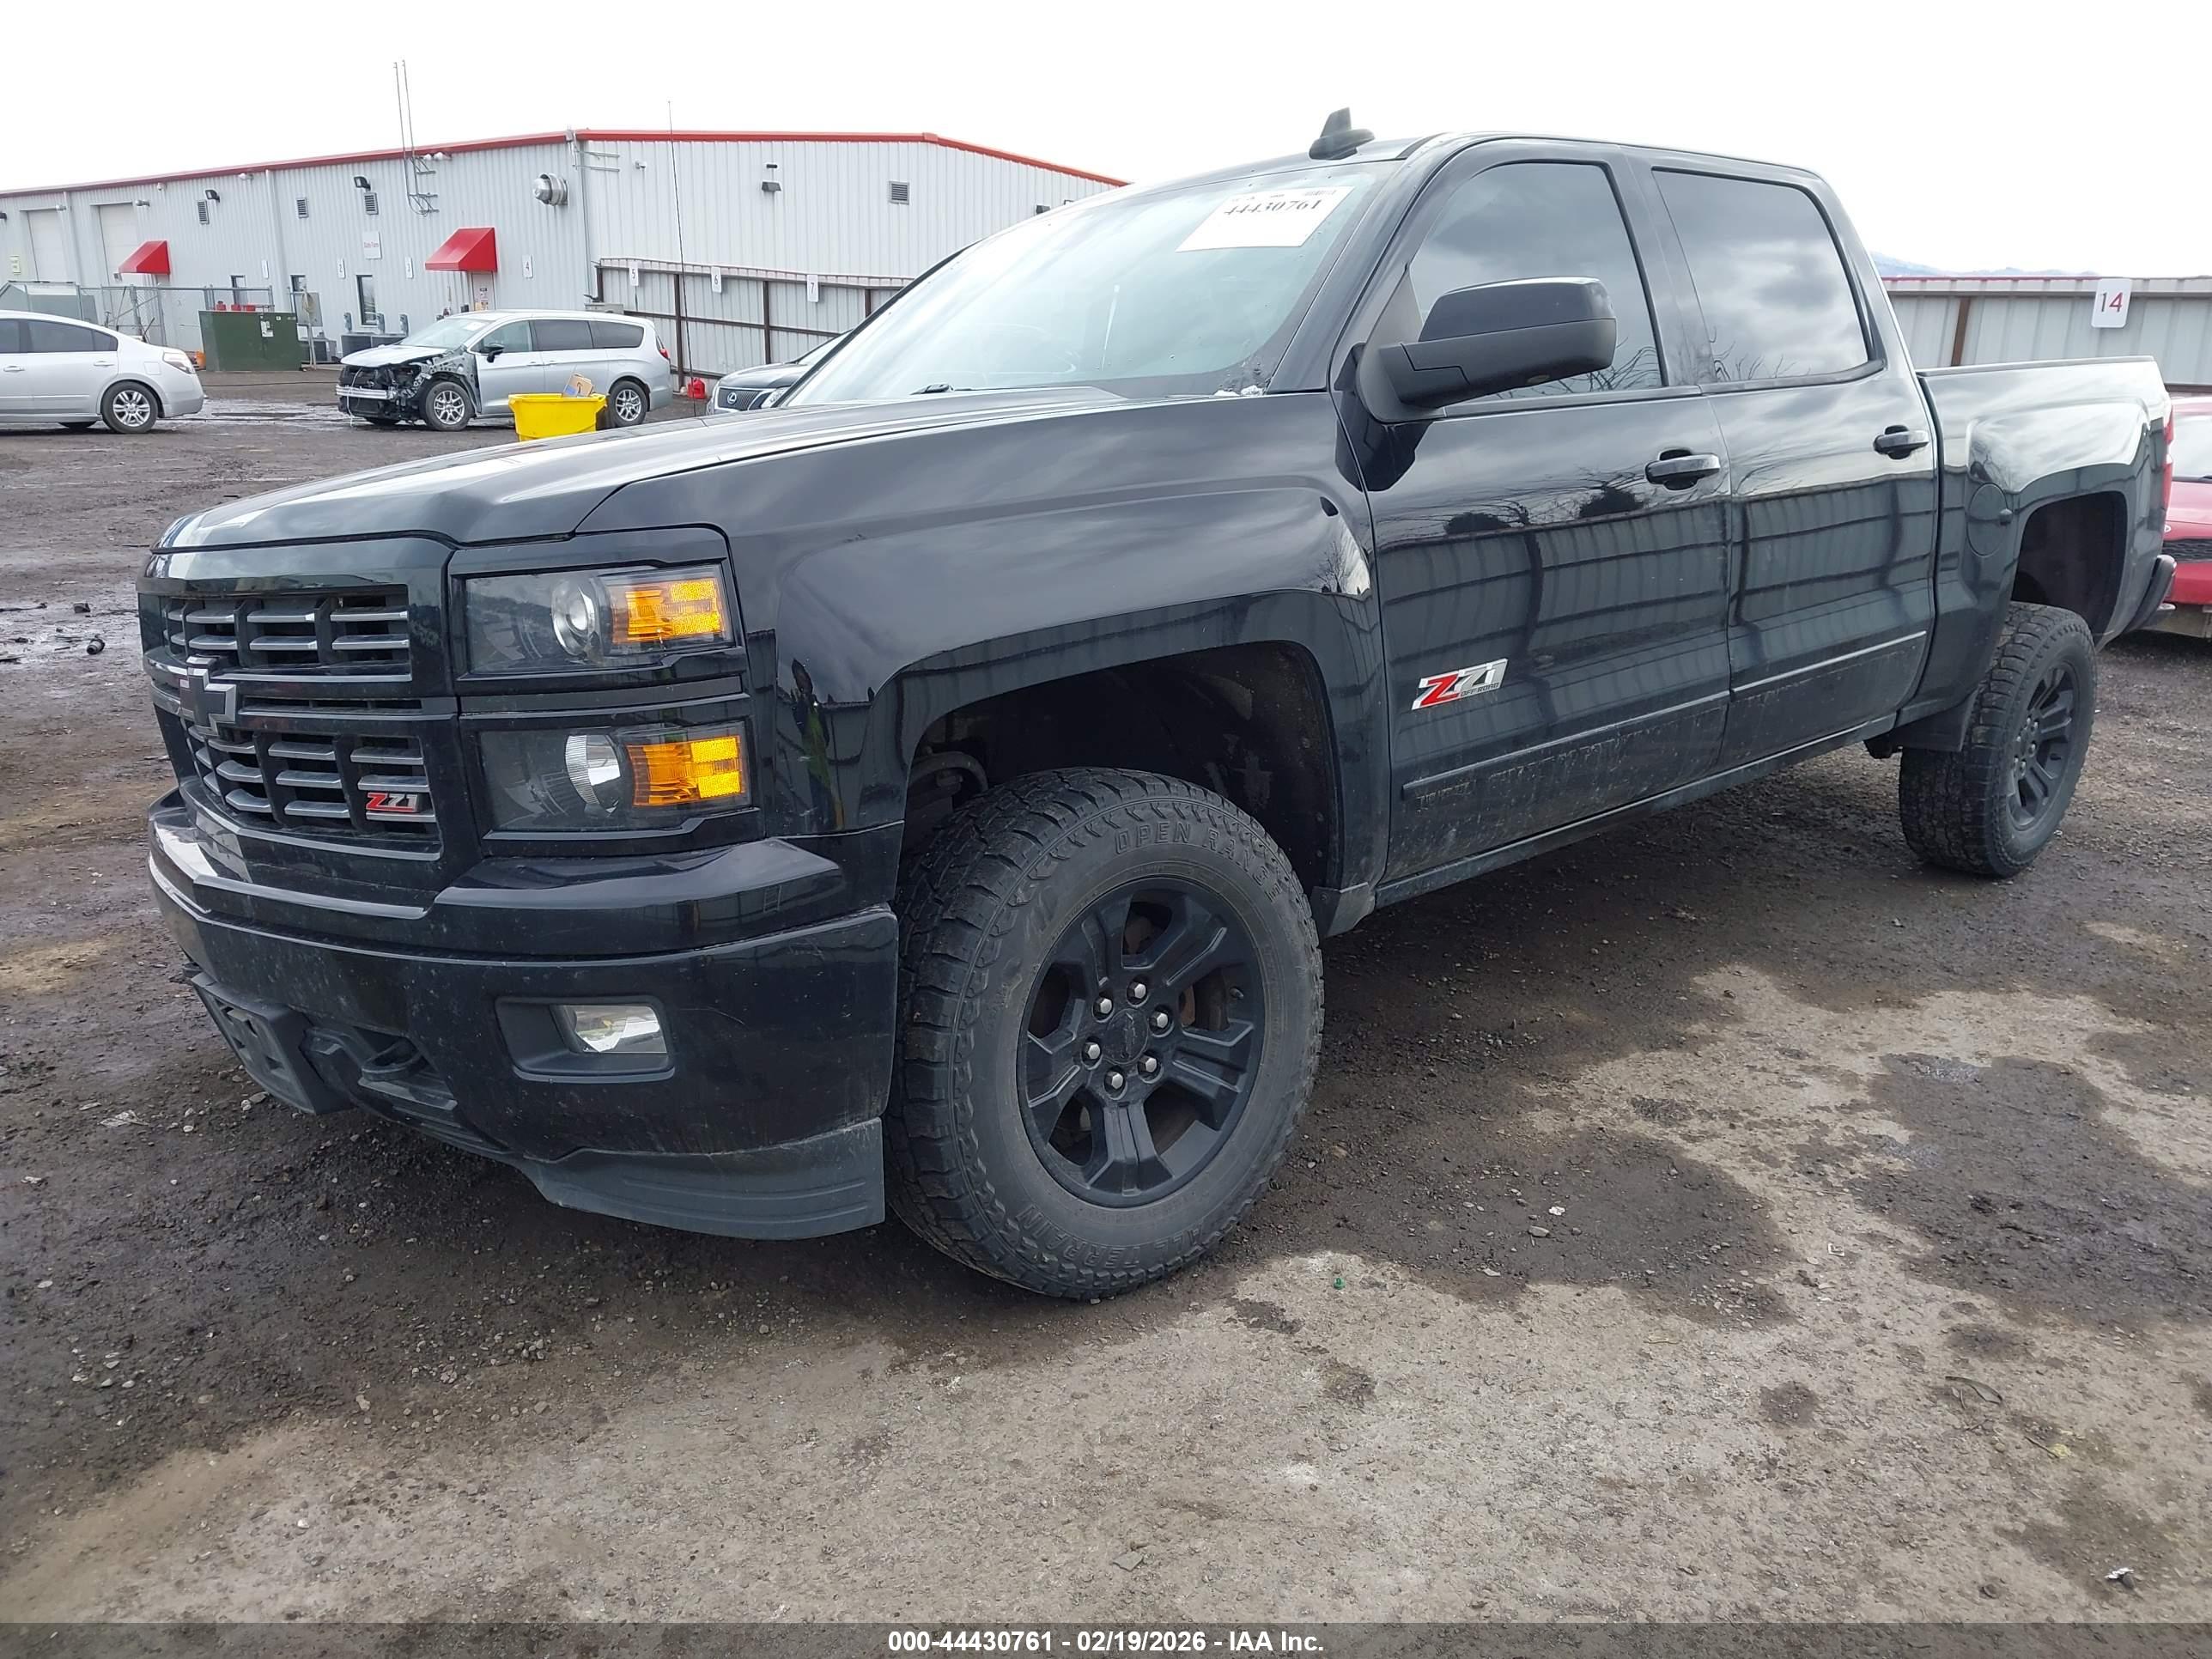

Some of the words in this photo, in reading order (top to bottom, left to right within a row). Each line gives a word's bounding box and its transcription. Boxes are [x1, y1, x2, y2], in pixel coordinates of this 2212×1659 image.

[1224, 198, 1323, 216] 44430761
[2100, 291, 2124, 313] 14
[1411, 658, 1509, 711] Z71
[365, 792, 419, 812] Z71
[1115, 820, 1191, 855] OPEN
